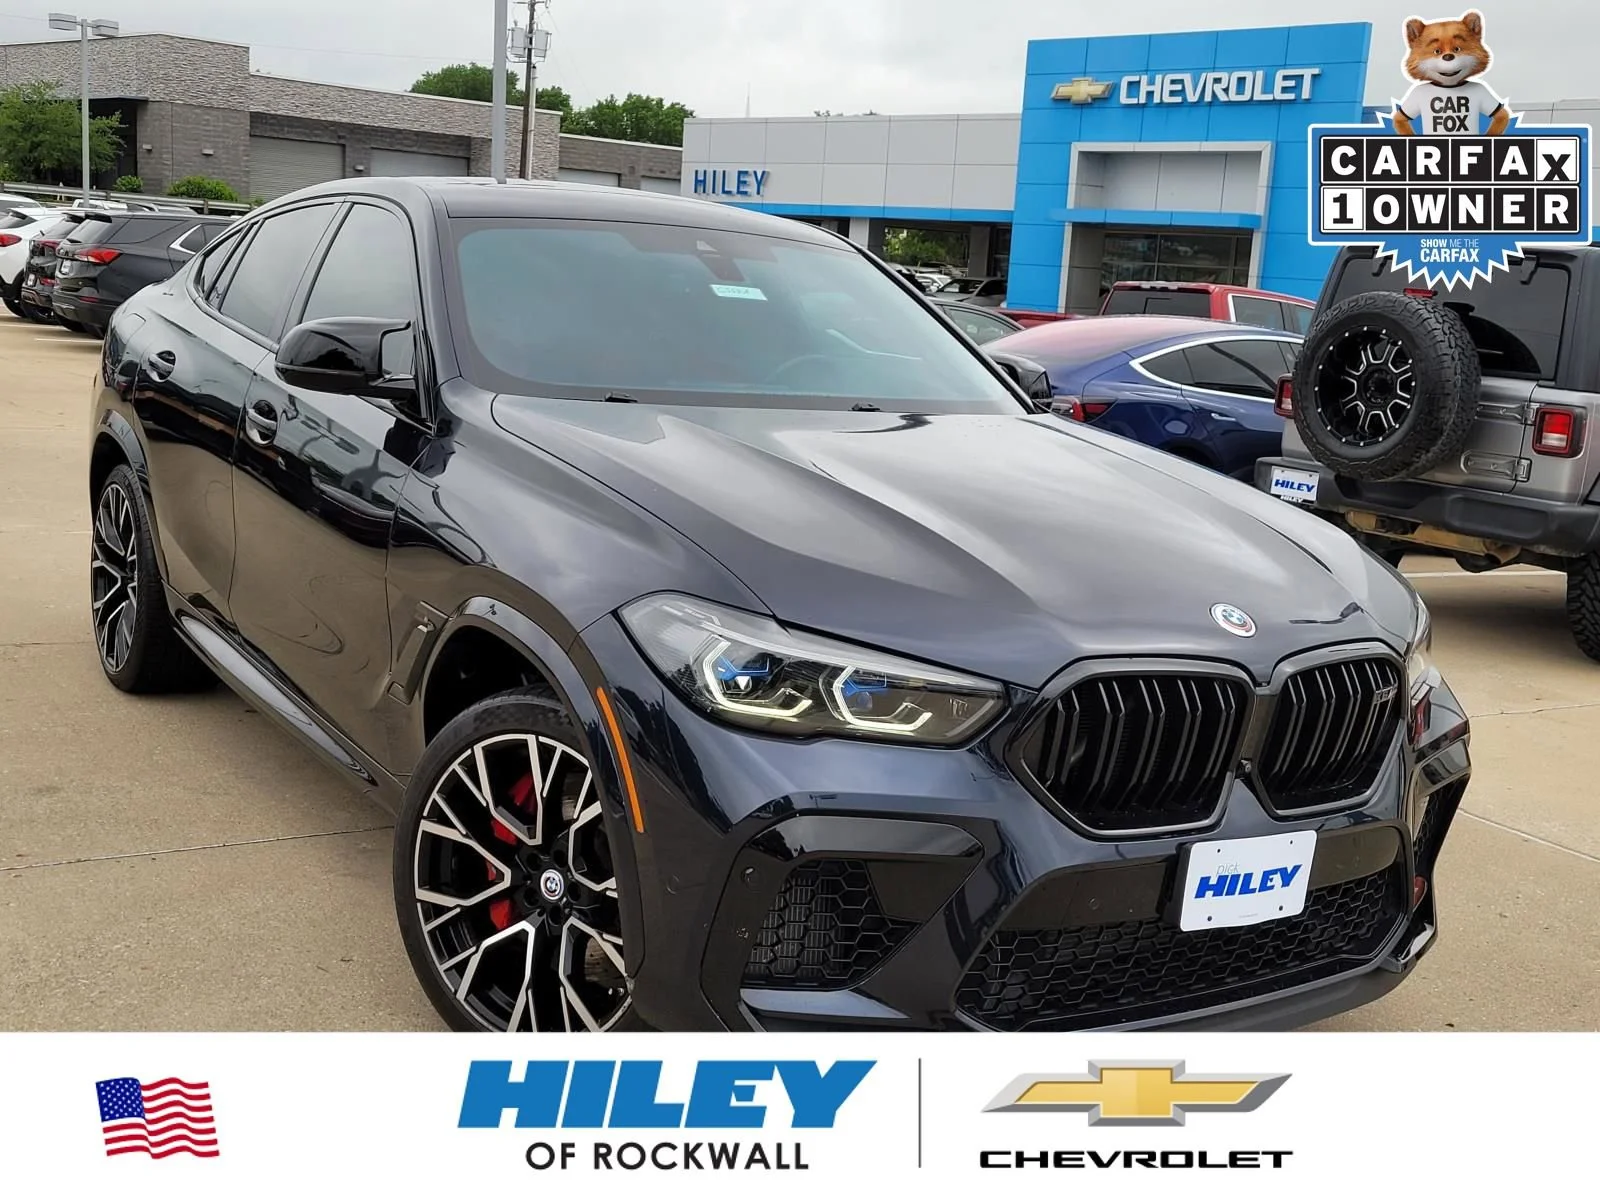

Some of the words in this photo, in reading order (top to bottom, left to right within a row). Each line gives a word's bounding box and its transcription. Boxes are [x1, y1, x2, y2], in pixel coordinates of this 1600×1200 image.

[1119, 68, 1321, 104] CHEVROLET
[694, 169, 767, 196] HILEY
[1274, 479, 1316, 492] HILEY
[1194, 864, 1303, 899] HILEY
